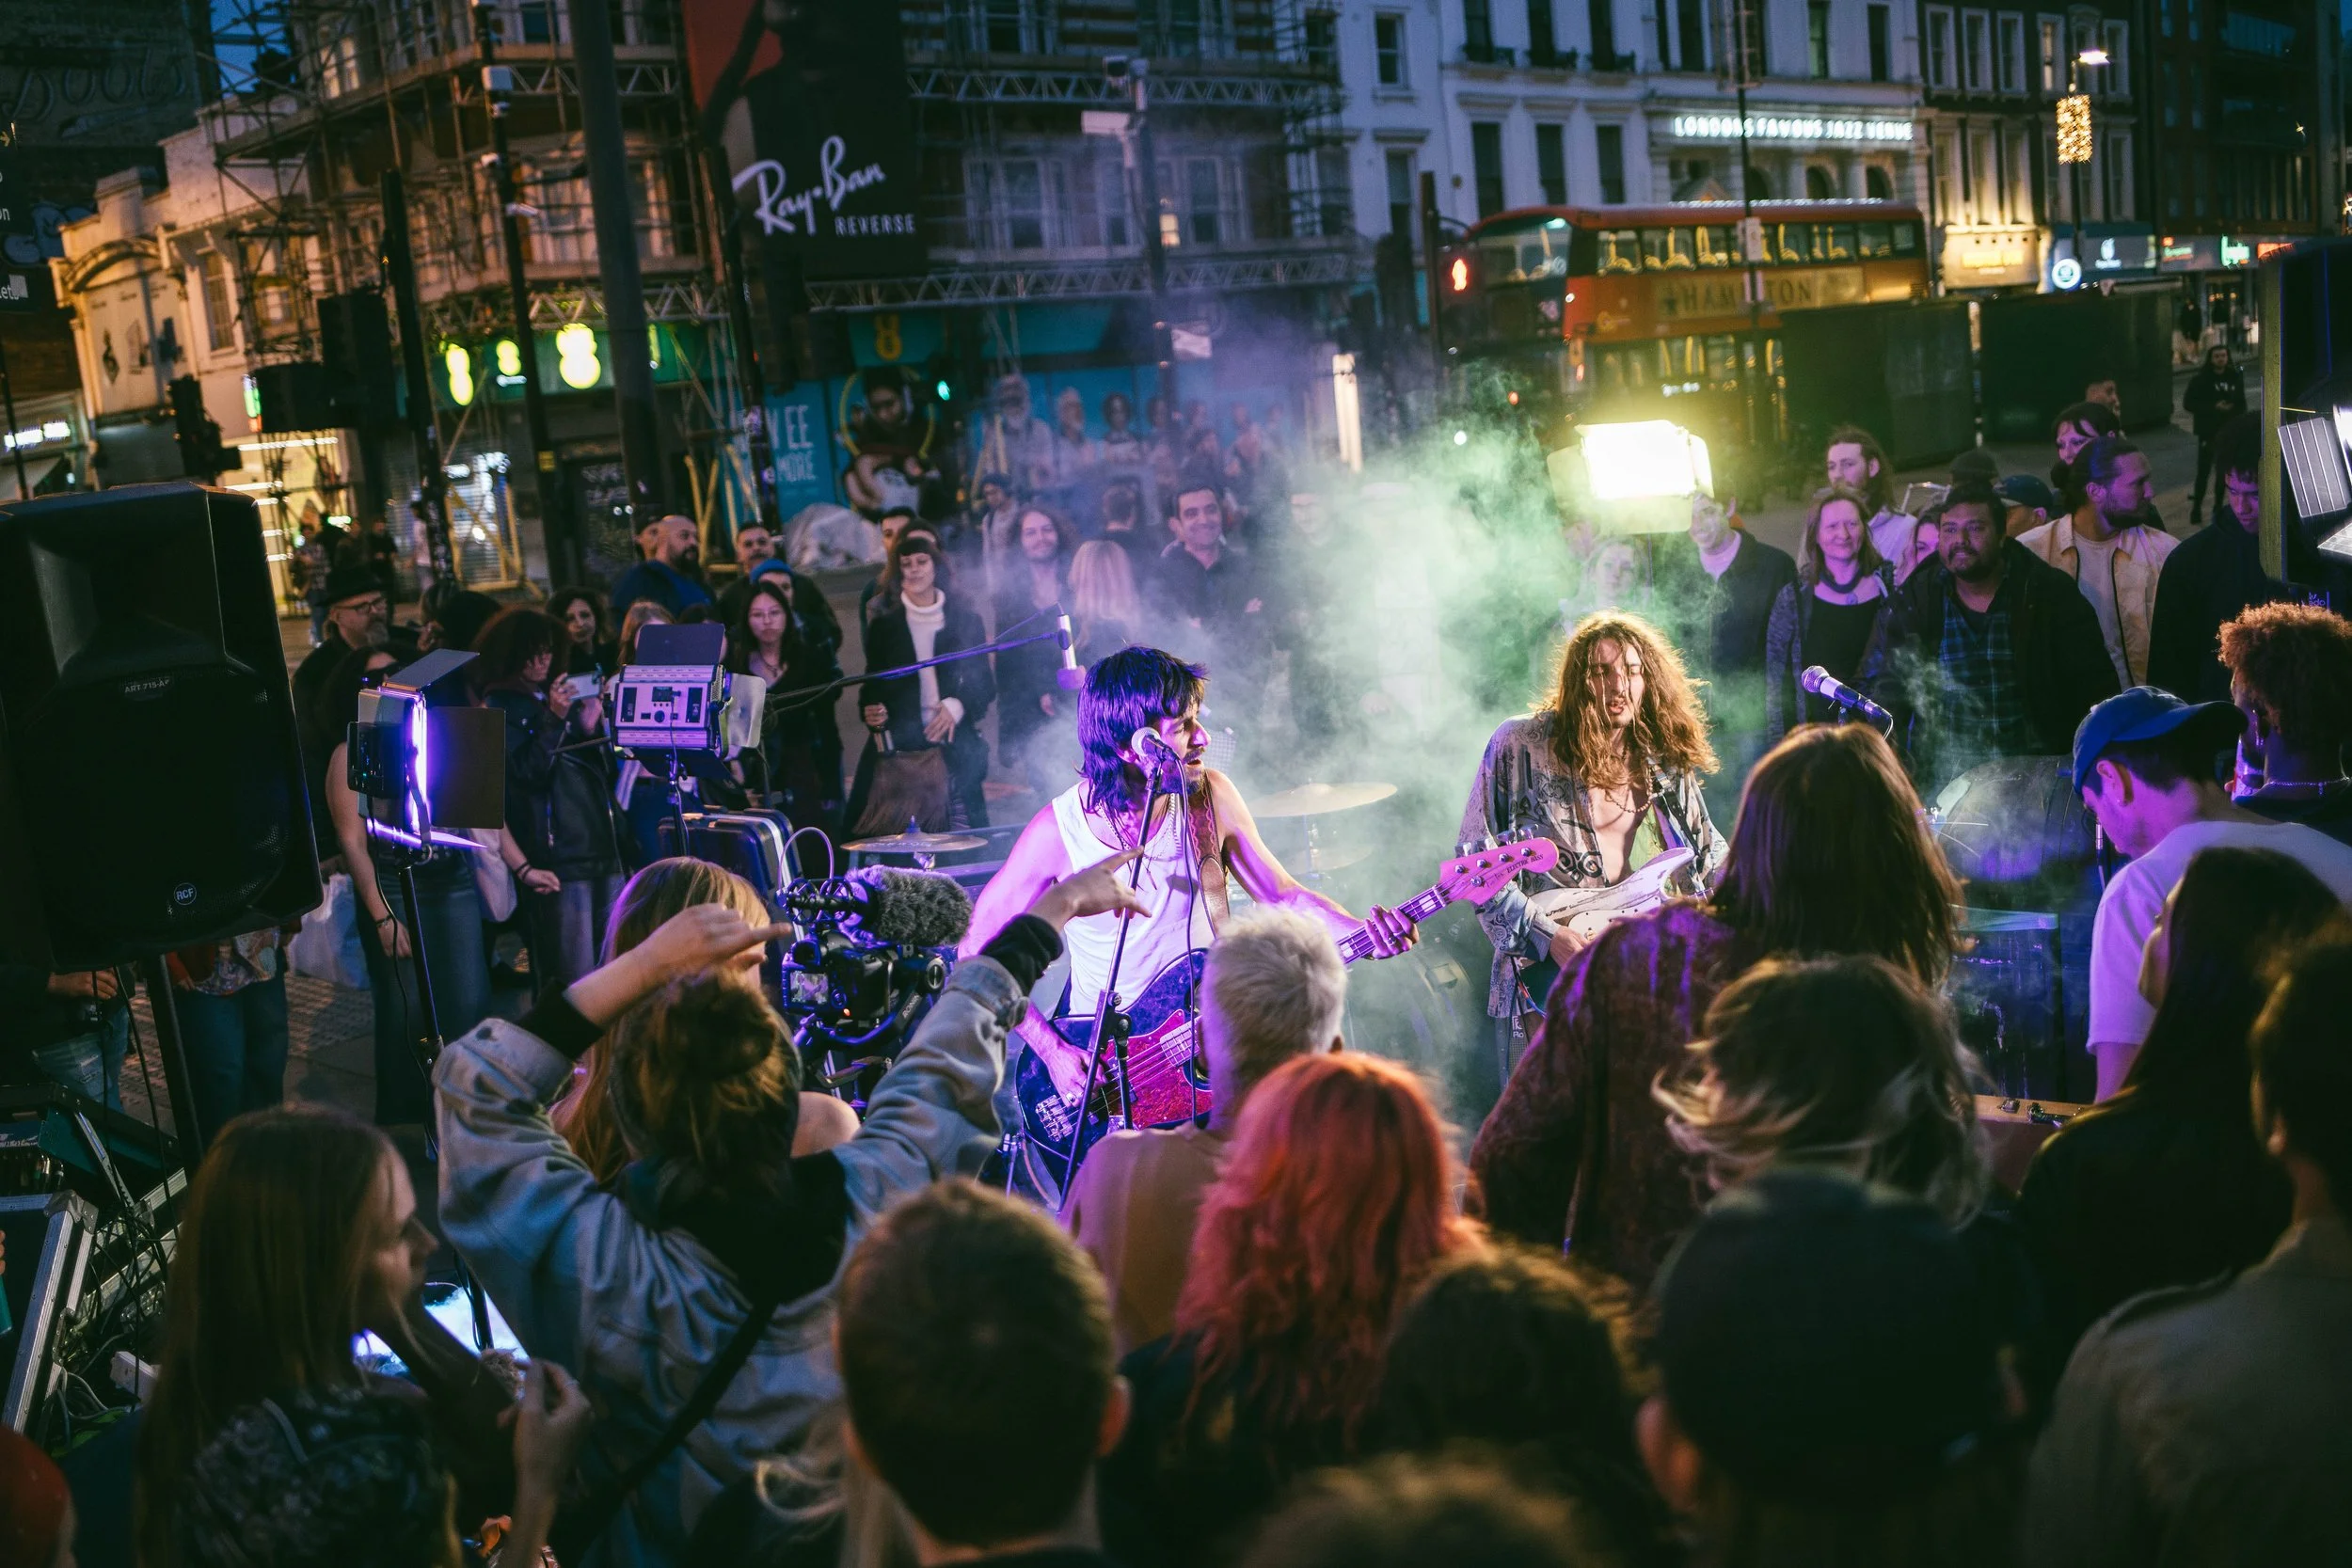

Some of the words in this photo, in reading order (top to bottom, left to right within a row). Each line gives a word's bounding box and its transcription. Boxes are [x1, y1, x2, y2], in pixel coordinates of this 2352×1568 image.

[834, 214, 916, 236] REVERSE
[124, 684, 141, 693] ART
[176, 888, 194, 900] RCF
